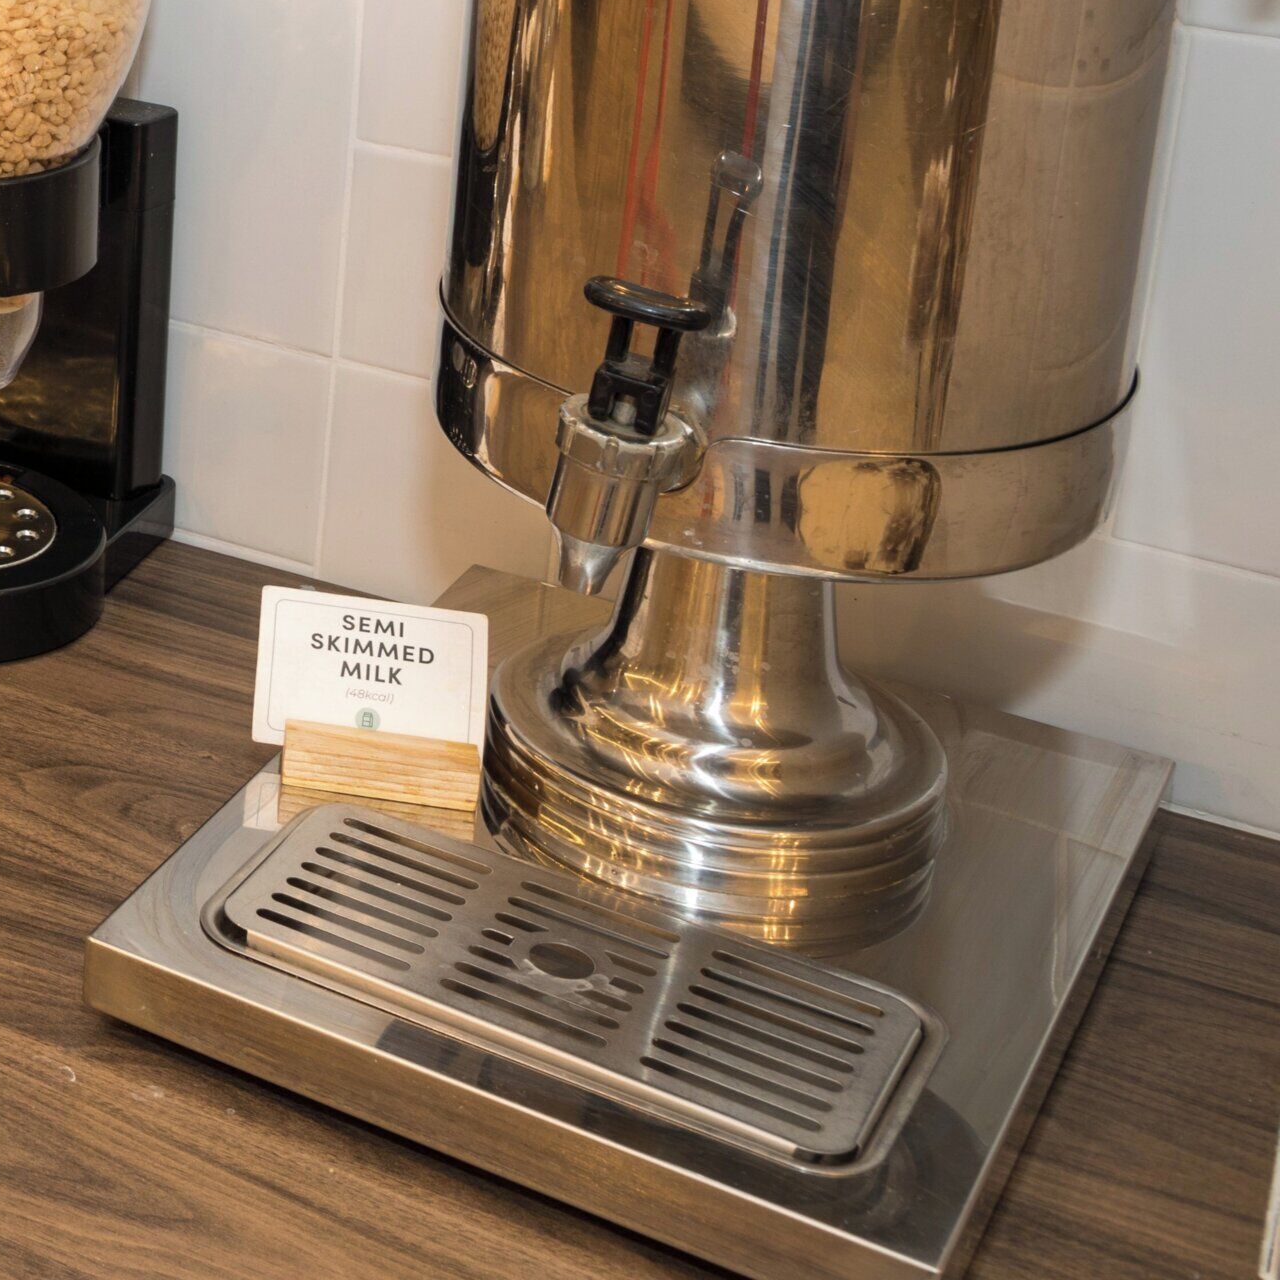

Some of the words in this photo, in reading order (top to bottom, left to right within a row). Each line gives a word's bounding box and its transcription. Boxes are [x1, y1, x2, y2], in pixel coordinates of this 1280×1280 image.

[342, 614, 404, 638] SEMI
[311, 633, 435, 664] SKIMMED
[340, 660, 402, 686] MILK
[345, 687, 395, 705] (48kcal)
